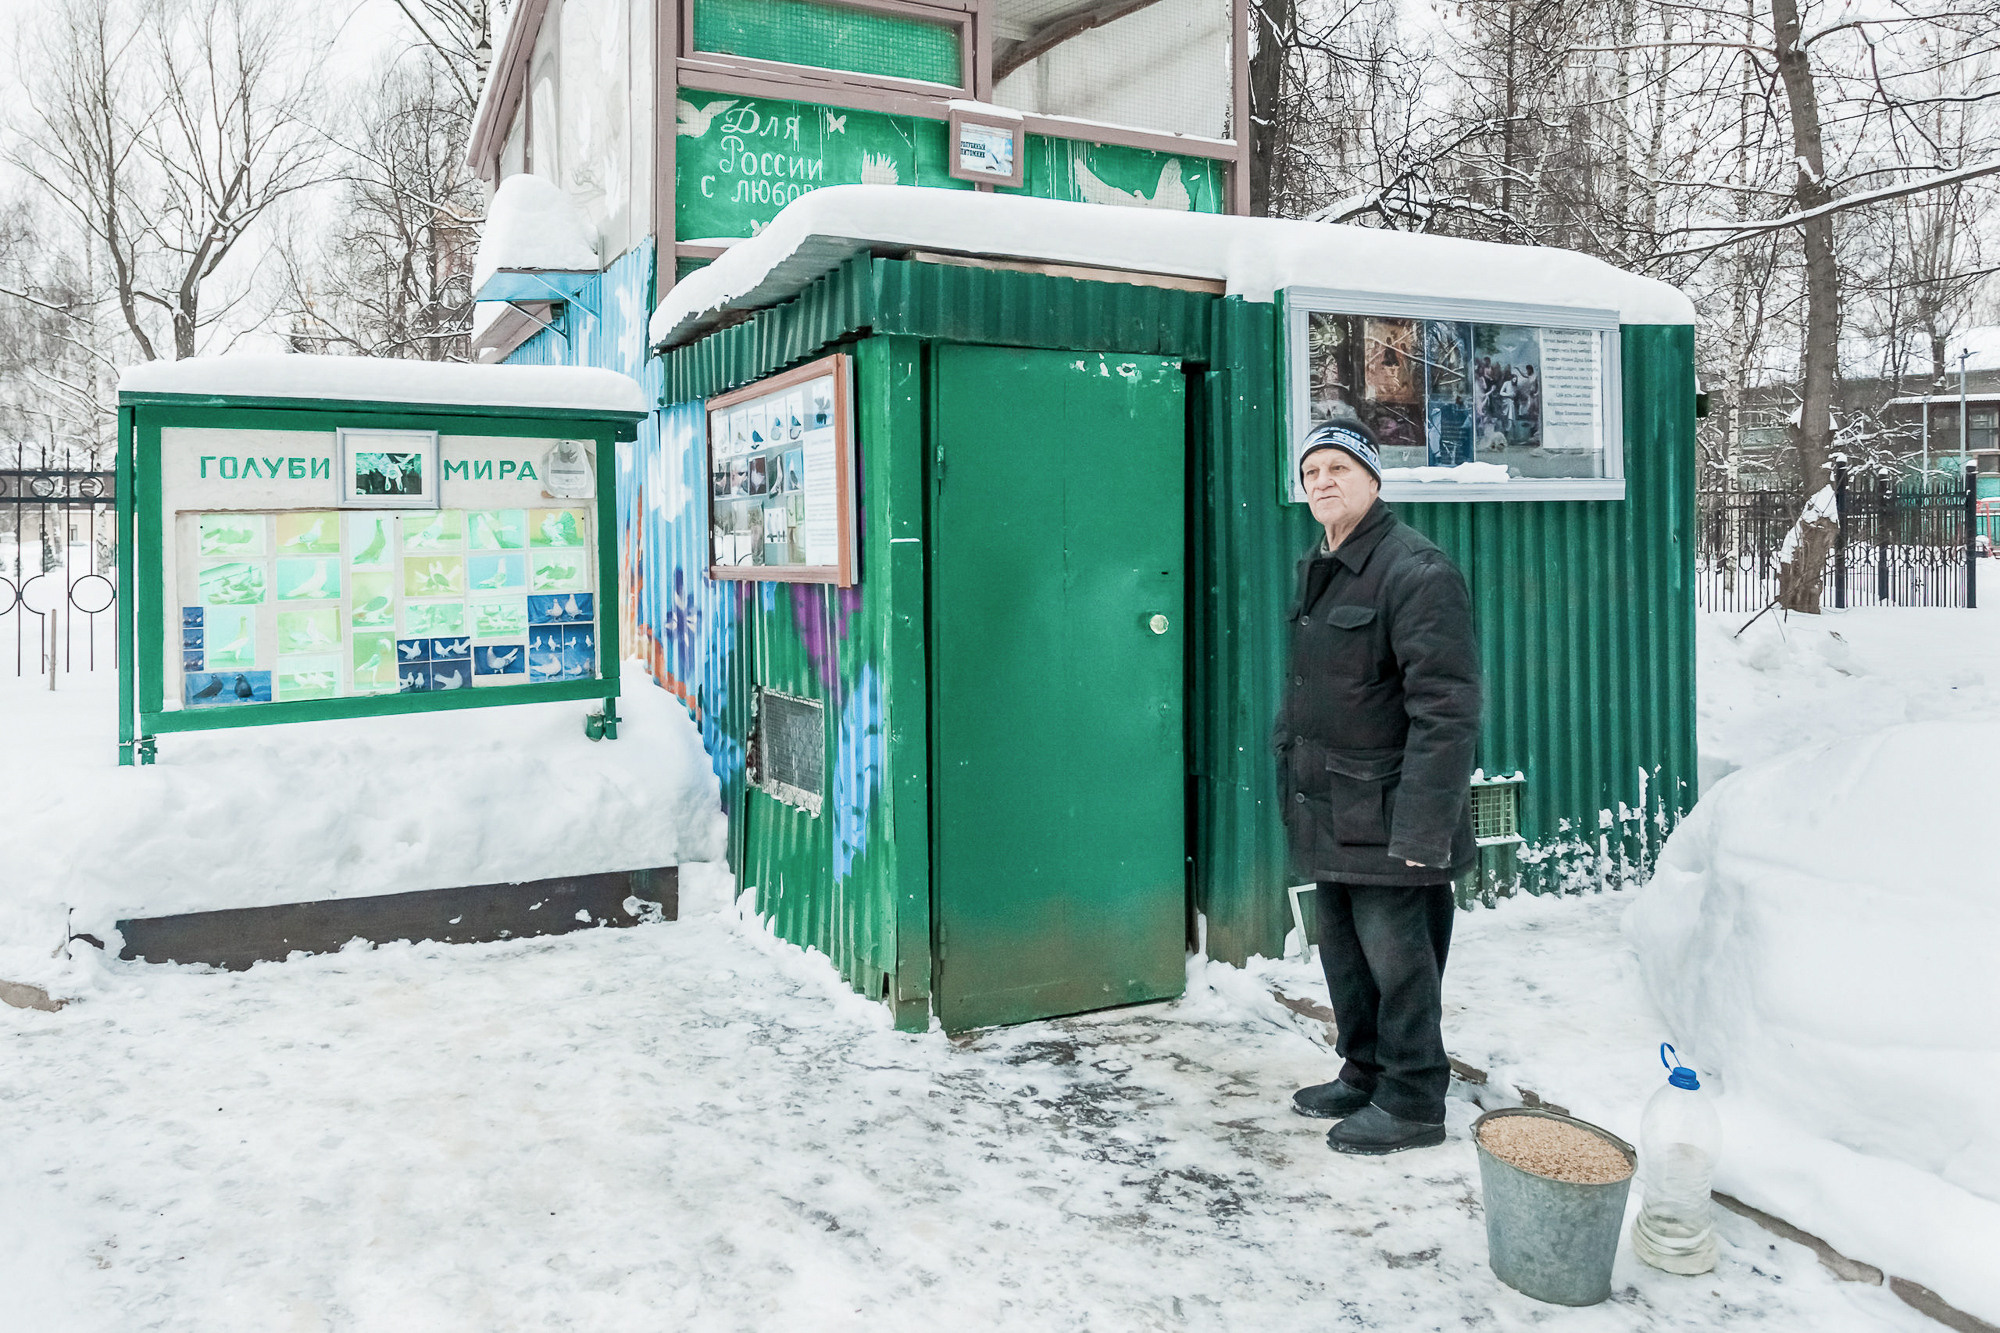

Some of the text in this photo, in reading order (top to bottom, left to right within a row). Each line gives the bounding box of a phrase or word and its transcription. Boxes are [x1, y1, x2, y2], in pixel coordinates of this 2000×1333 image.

[720, 102, 801, 140] Для
[719, 135, 823, 181] России
[200, 455, 539, 481] ГОЛУБИ МИРА
